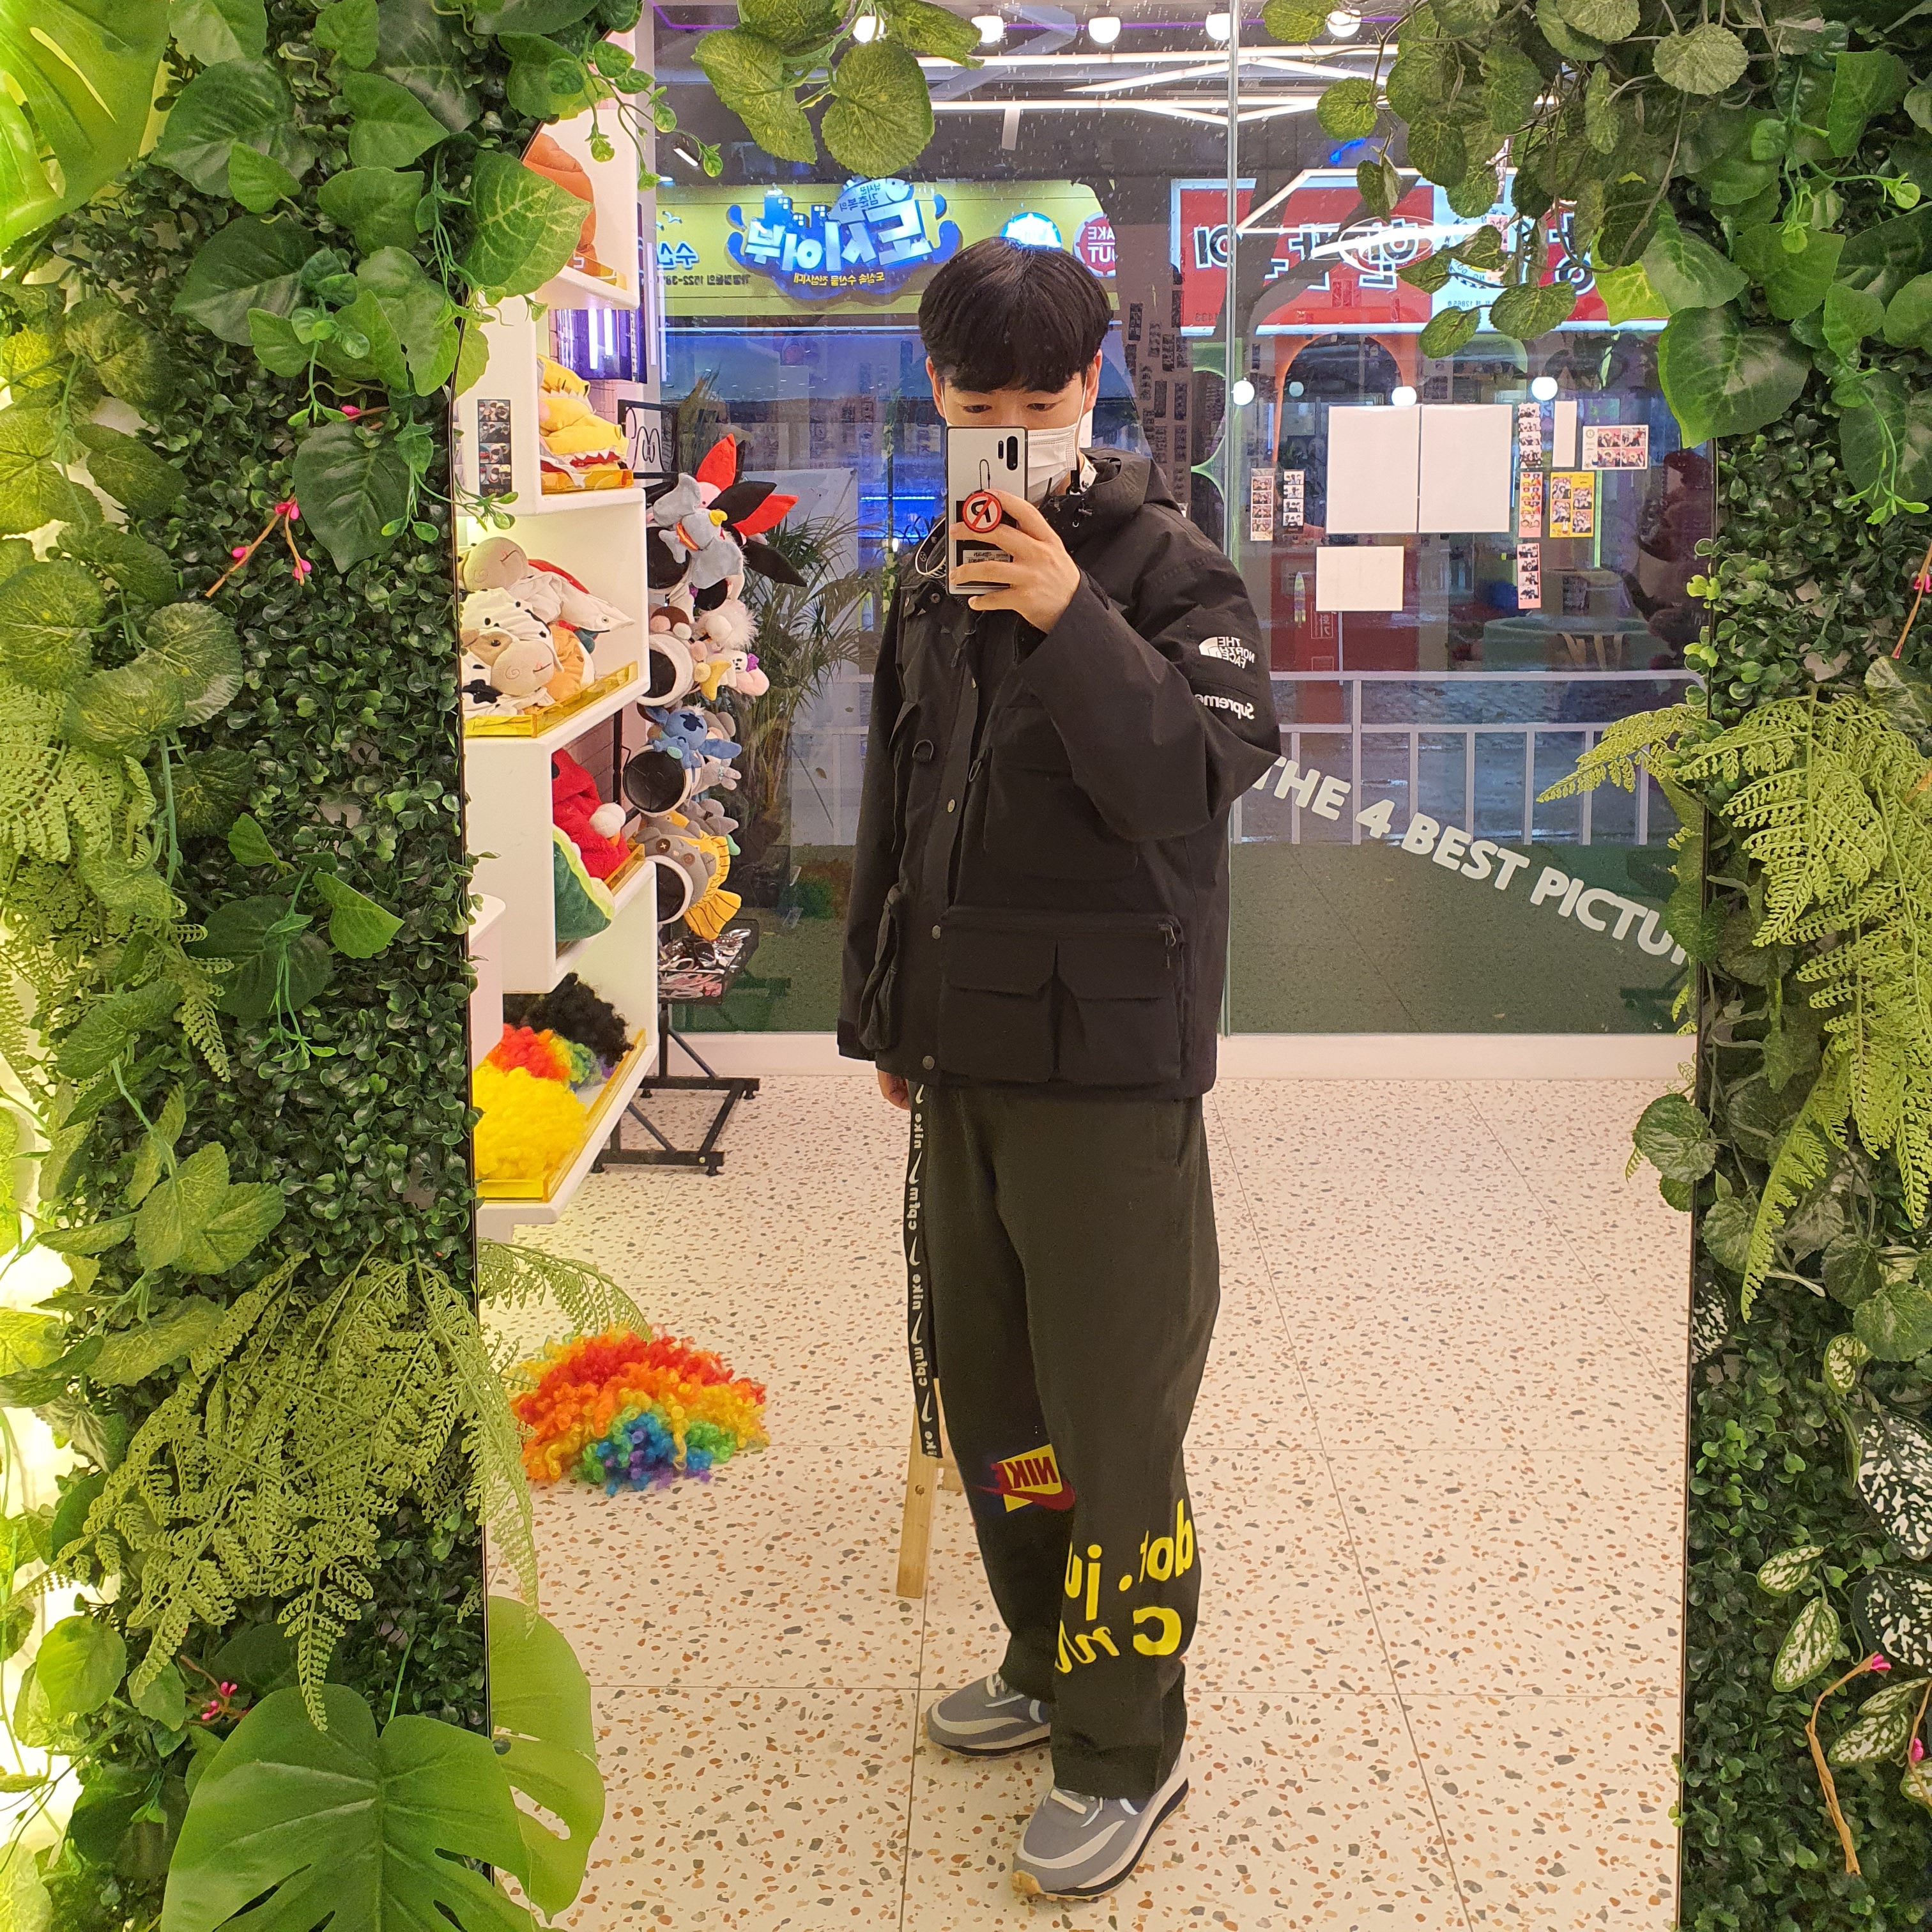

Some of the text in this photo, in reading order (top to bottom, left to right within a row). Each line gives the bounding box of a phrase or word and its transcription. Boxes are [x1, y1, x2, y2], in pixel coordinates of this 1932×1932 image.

[1252, 756, 1688, 967] THE 4 BEST PICTU
